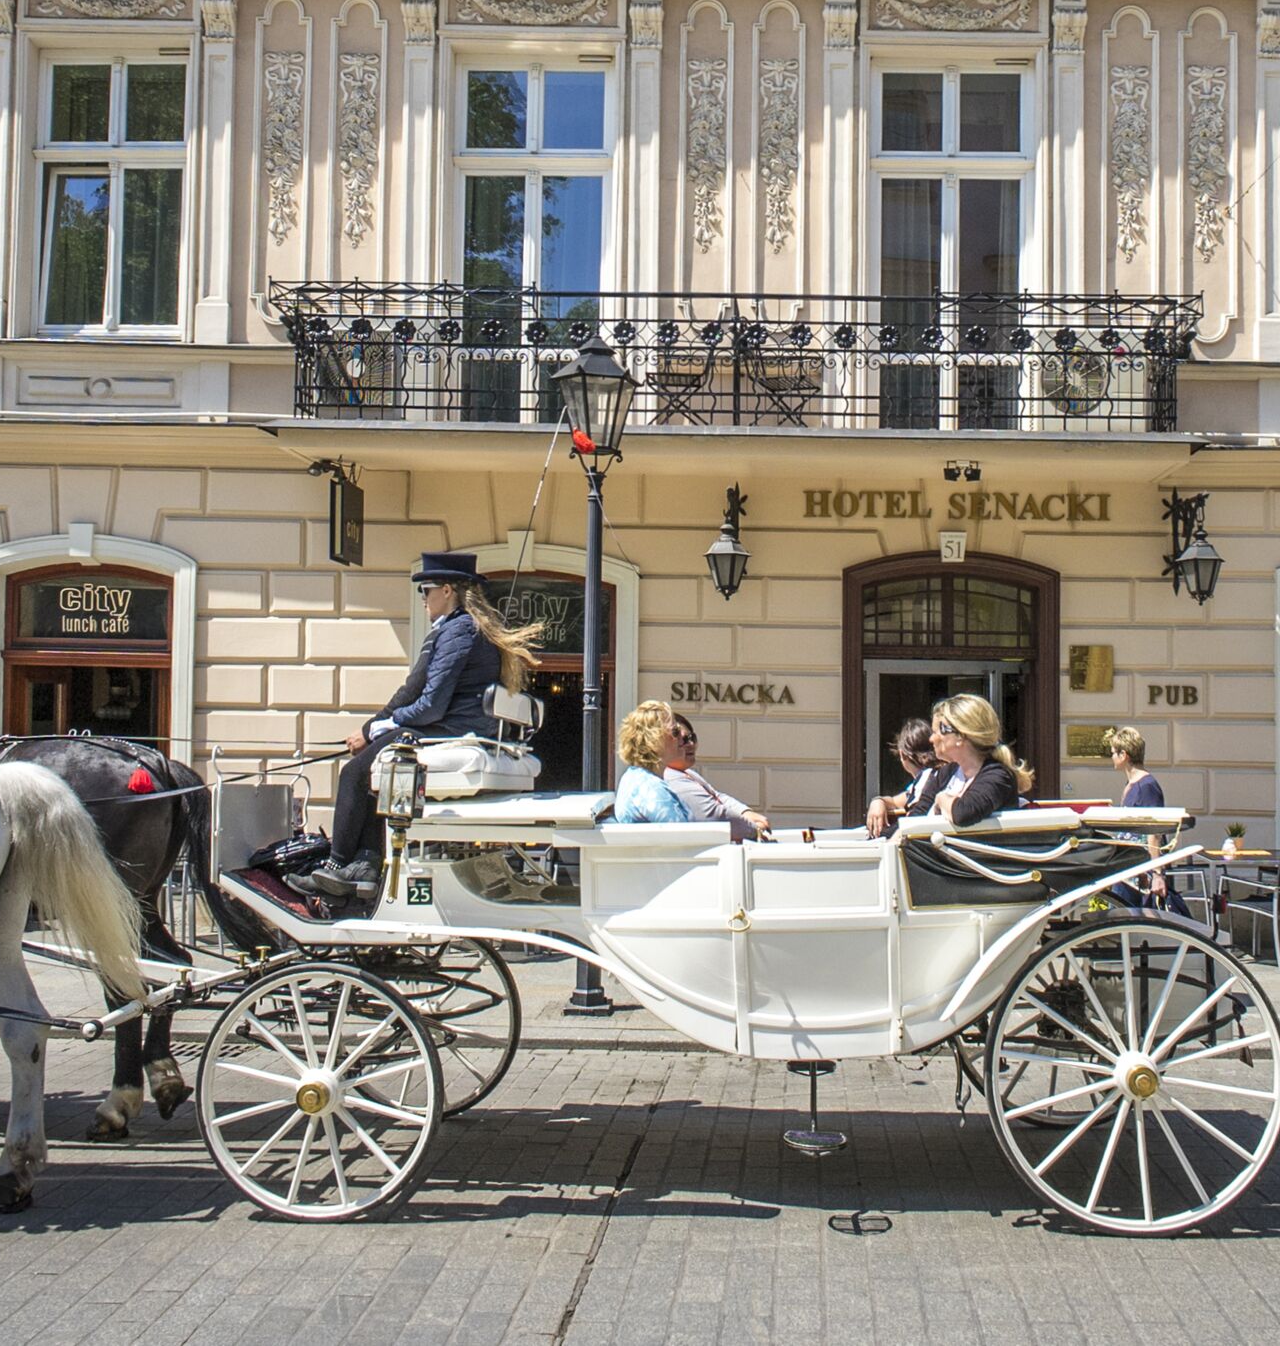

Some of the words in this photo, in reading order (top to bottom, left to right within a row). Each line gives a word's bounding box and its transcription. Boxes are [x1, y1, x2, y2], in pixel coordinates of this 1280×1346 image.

[803, 490, 932, 519] HOTEL
[948, 492, 1111, 521] SENACKI
[944, 540, 962, 559] 51
[60, 583, 131, 616] city
[497, 591, 570, 624] city
[62, 615, 97, 633] lunch
[101, 615, 130, 633] café
[671, 681, 795, 704] SENACKA
[1148, 685, 1198, 705] PUB
[410, 887, 431, 902] 25
